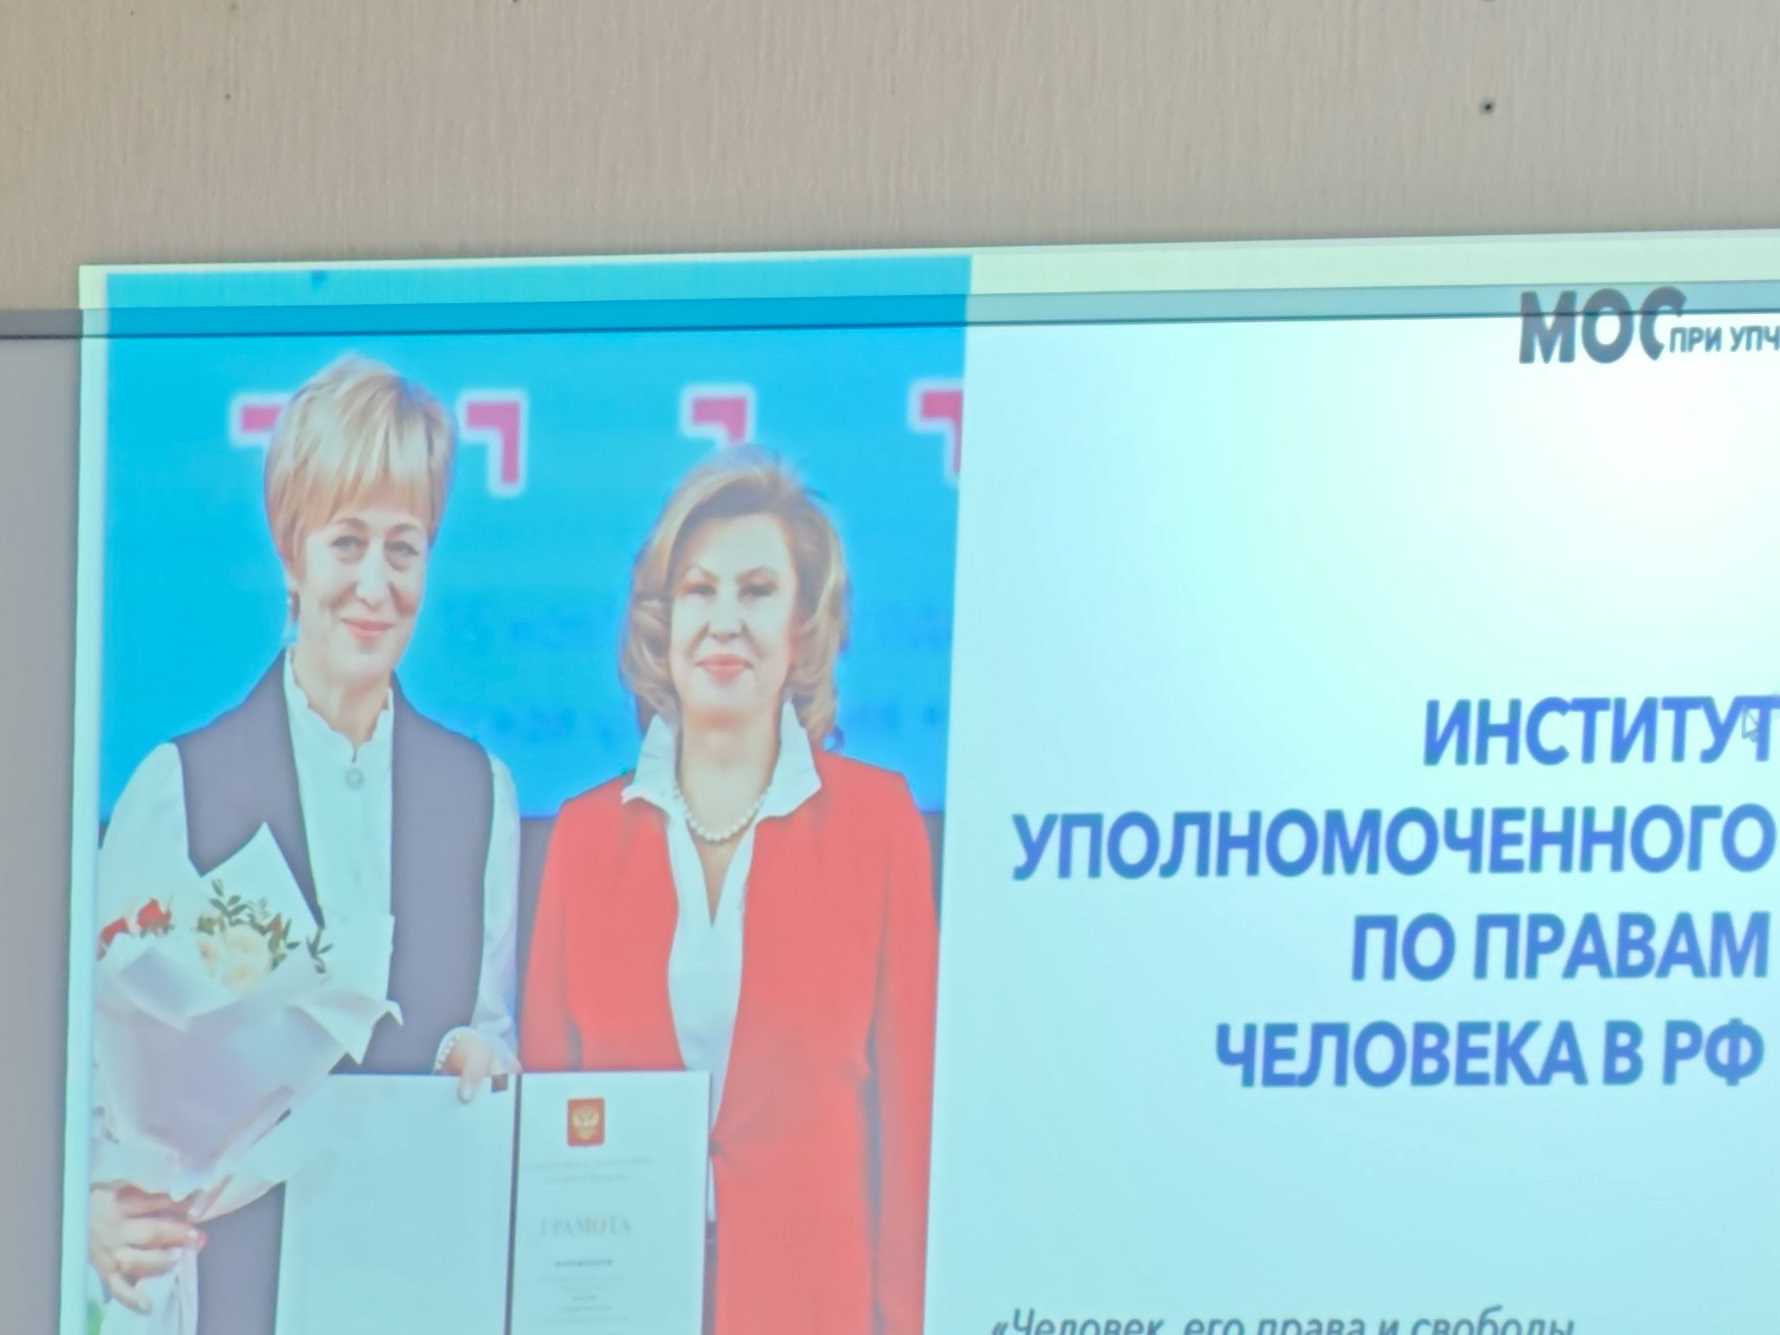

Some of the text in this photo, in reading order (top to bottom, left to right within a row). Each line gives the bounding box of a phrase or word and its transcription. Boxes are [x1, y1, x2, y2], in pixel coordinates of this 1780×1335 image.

[1520, 286, 1687, 364] МОС
[1669, 325, 1780, 353] ПРИ УПЧ
[1423, 696, 1780, 766] ИНСТИТУТ
[1012, 804, 1776, 881] УПОЛНОМОЧЕННОГО
[1351, 912, 1770, 981] ПО ПРАВАМ
[1217, 1018, 1765, 1087] ЧЕЛОВЕКА В РФ
